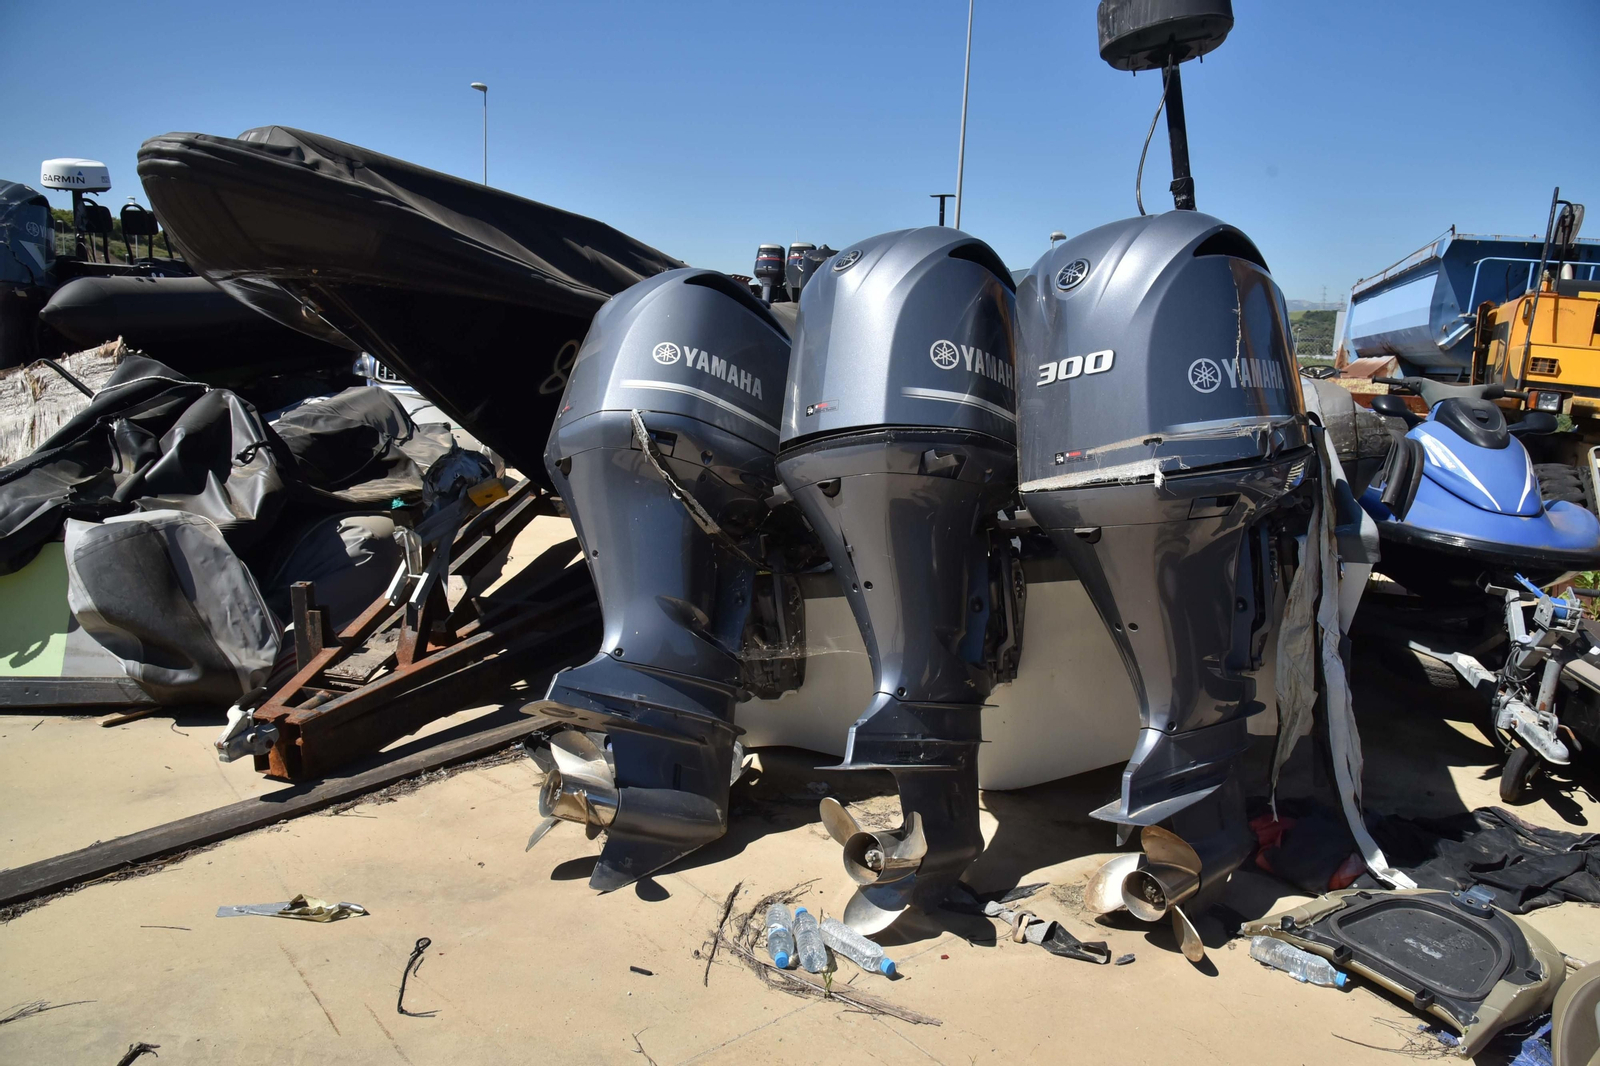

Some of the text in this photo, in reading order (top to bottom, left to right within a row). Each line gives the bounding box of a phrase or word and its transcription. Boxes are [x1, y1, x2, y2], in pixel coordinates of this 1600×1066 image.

[43, 174, 85, 184] GARMIN
[683, 345, 763, 400] YAMAHA
[960, 344, 1015, 391] YAMAH
[1036, 349, 1115, 387] 300
[1221, 358, 1285, 389] YAMAHA
